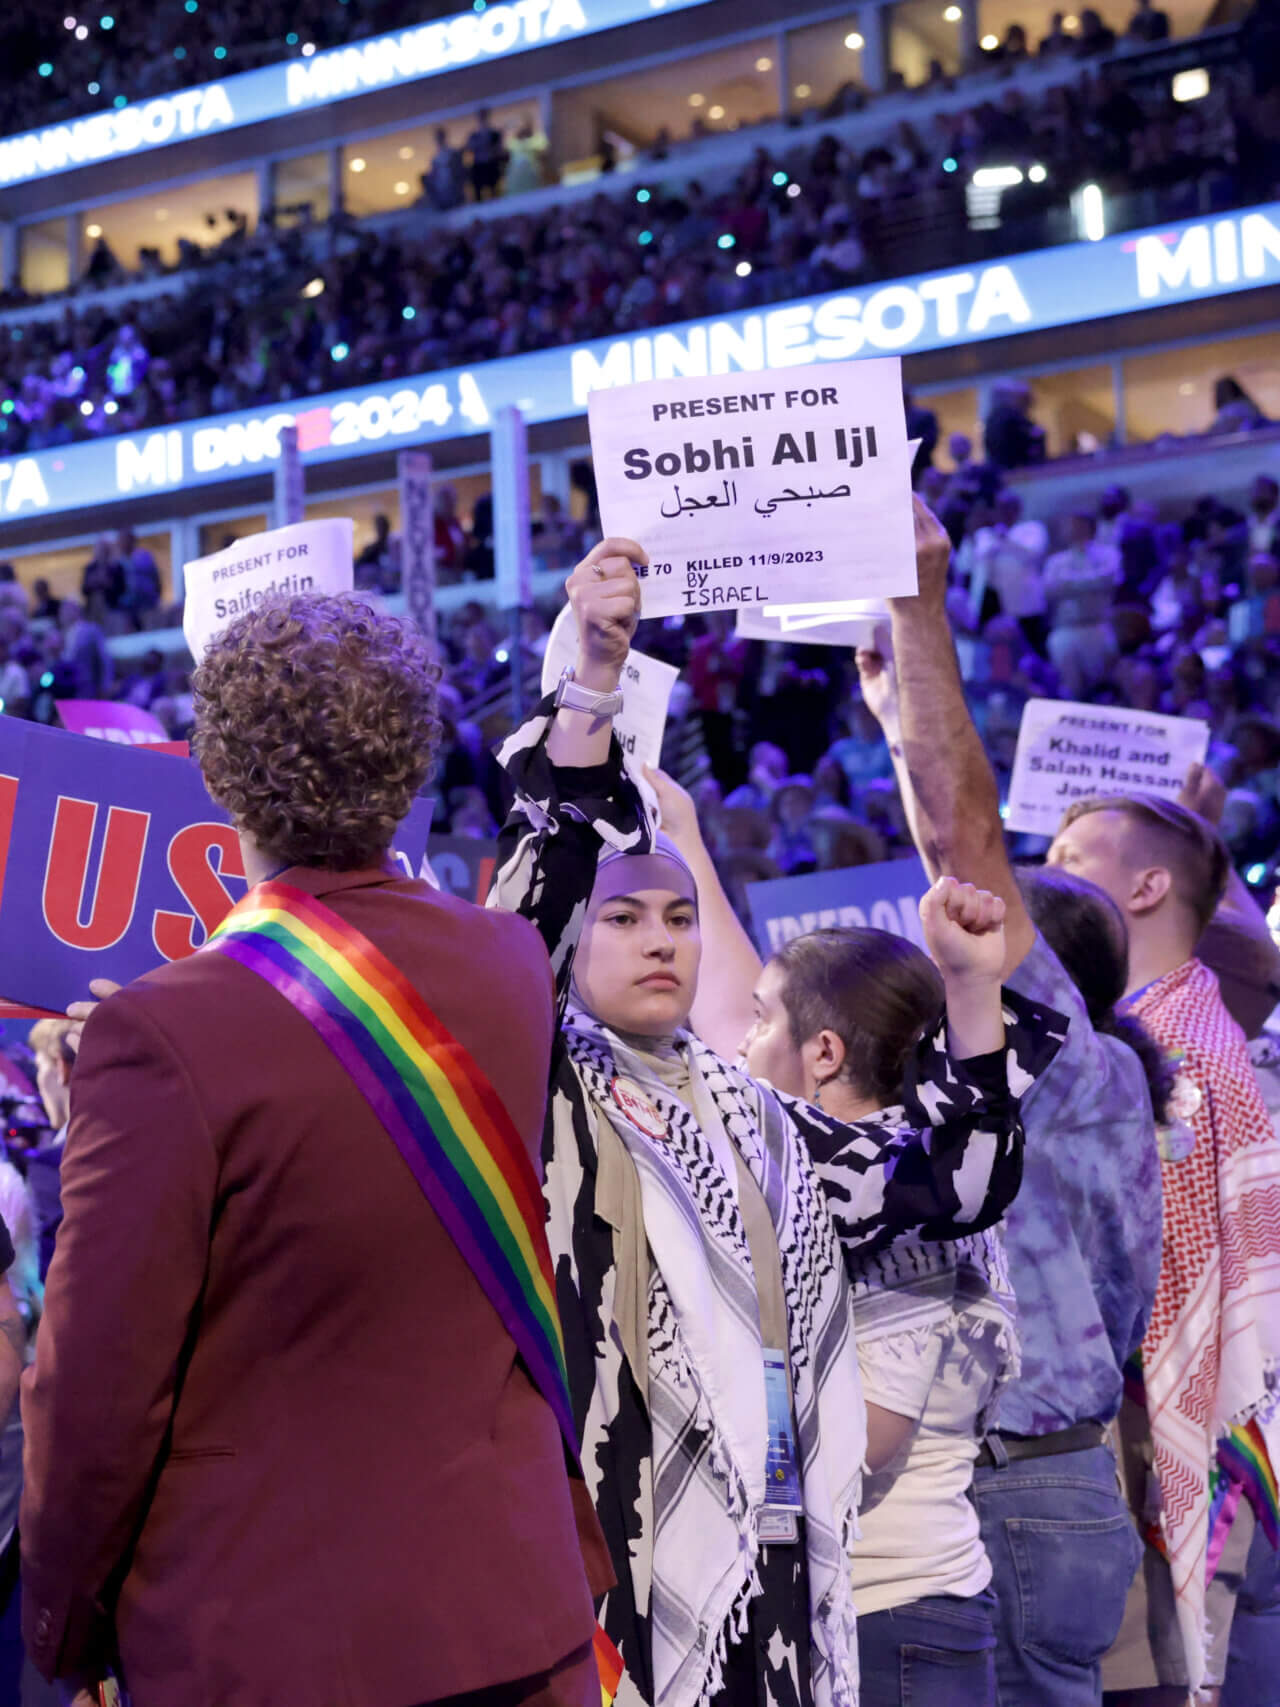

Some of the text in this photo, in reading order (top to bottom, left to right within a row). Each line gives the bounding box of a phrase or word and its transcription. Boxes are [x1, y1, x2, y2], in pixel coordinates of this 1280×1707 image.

[286, 0, 586, 106] MINNESOTA
[571, 265, 1032, 406] MINNESOTA
[329, 384, 454, 446] 2024
[652, 387, 839, 422] PRESENT FOR
[623, 436, 755, 480] Sobhi
[771, 431, 818, 466] Al
[660, 480, 852, 518] صبحي العجل
[212, 544, 309, 583] PRESENT FOR
[654, 562, 673, 577] 70
[686, 555, 744, 573] KILLED
[747, 550, 825, 569] 11/9/2023
[682, 585, 769, 607] ISRAEL
[1049, 737, 1171, 766] Khalid and
[1029, 756, 1185, 789] Salah Hassan
